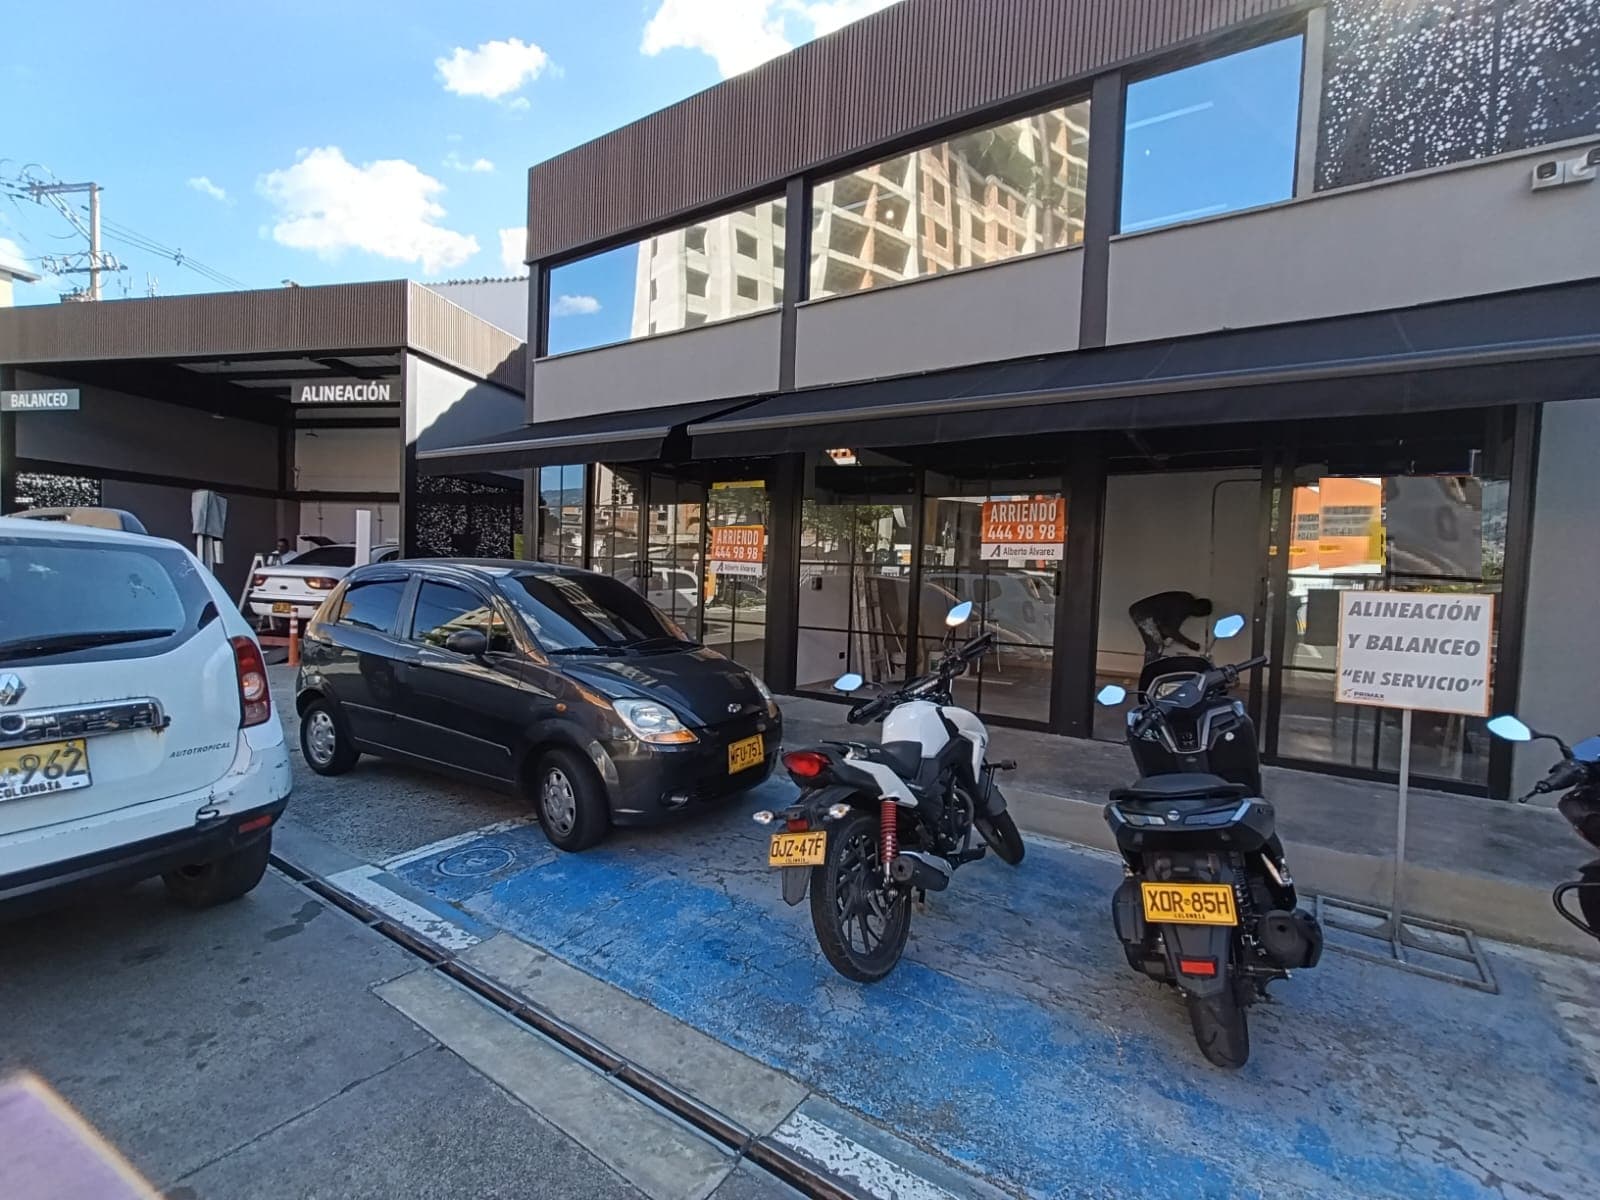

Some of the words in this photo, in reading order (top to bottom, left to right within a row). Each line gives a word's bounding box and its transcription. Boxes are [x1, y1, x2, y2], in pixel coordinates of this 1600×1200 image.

[301, 380, 390, 402] ALINEACIÓN
[10, 392, 68, 408] BALANCEO
[990, 502, 1057, 523] ARRIENDO
[716, 529, 759, 546] ARRIENDO
[988, 524, 1013, 540] 444
[1017, 524, 1034, 540] 98
[1039, 524, 1056, 540] 98
[714, 545, 731, 559] 444
[733, 546, 744, 560] 98
[747, 546, 759, 560] 98
[1003, 546, 1027, 556] Alberto
[1348, 600, 1482, 621] ALINEACIÓN
[1348, 633, 1362, 649] Y
[1366, 634, 1481, 657] BALANCEO
[169, 742, 230, 758] AUTOTROPICAL
